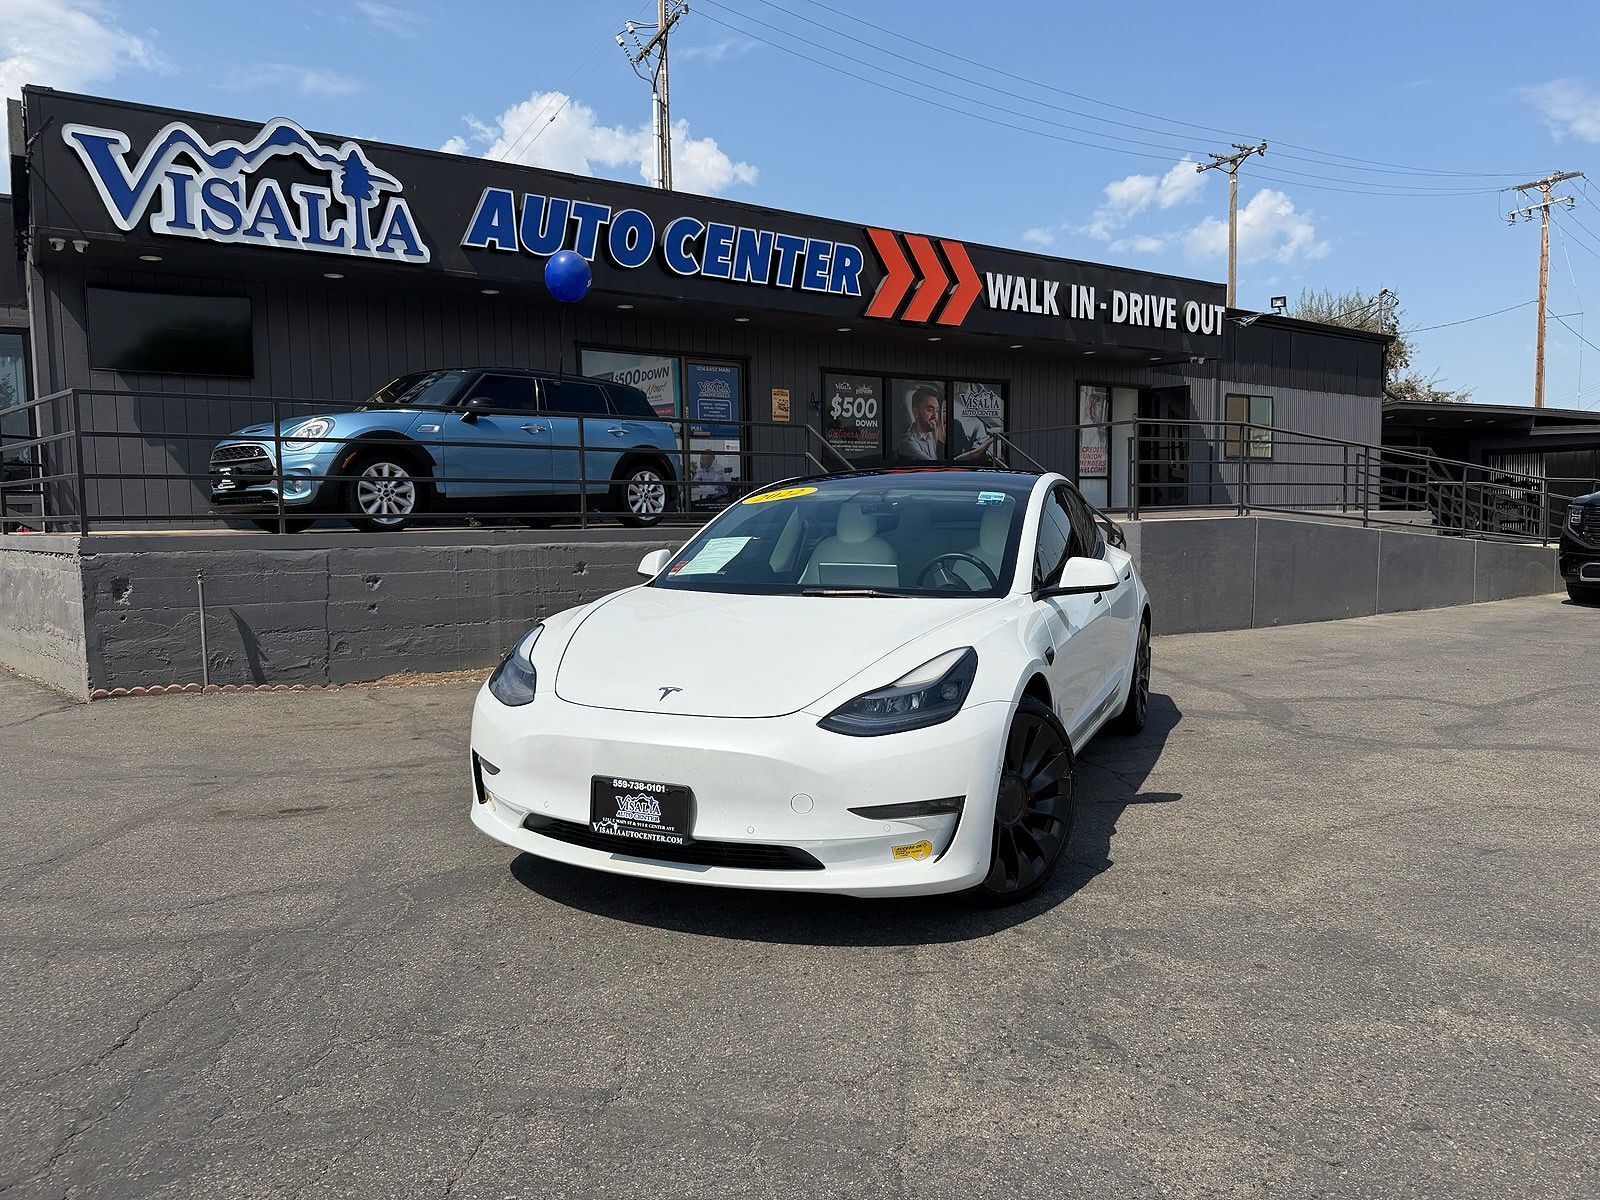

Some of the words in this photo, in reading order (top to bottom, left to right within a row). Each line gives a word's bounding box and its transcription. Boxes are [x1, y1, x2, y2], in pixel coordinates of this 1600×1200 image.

[62, 117, 430, 263] VISALIA
[461, 187, 655, 268] AUTO
[663, 216, 864, 297] CENTER
[985, 272, 1060, 316] WALK
[1070, 284, 1096, 320] IN
[1112, 289, 1177, 330] DRIVE
[1185, 299, 1226, 336] OUT
[641, 366, 670, 382] DOWN
[830, 393, 878, 420] $500
[960, 387, 1000, 409] VISALIA
[855, 419, 878, 427] DOWN
[977, 409, 1000, 417] CENTER
[612, 779, 666, 793] 559-738-0101
[615, 793, 661, 816] VISALIA
[616, 810, 634, 819] AUTO
[634, 812, 660, 823] CENTER
